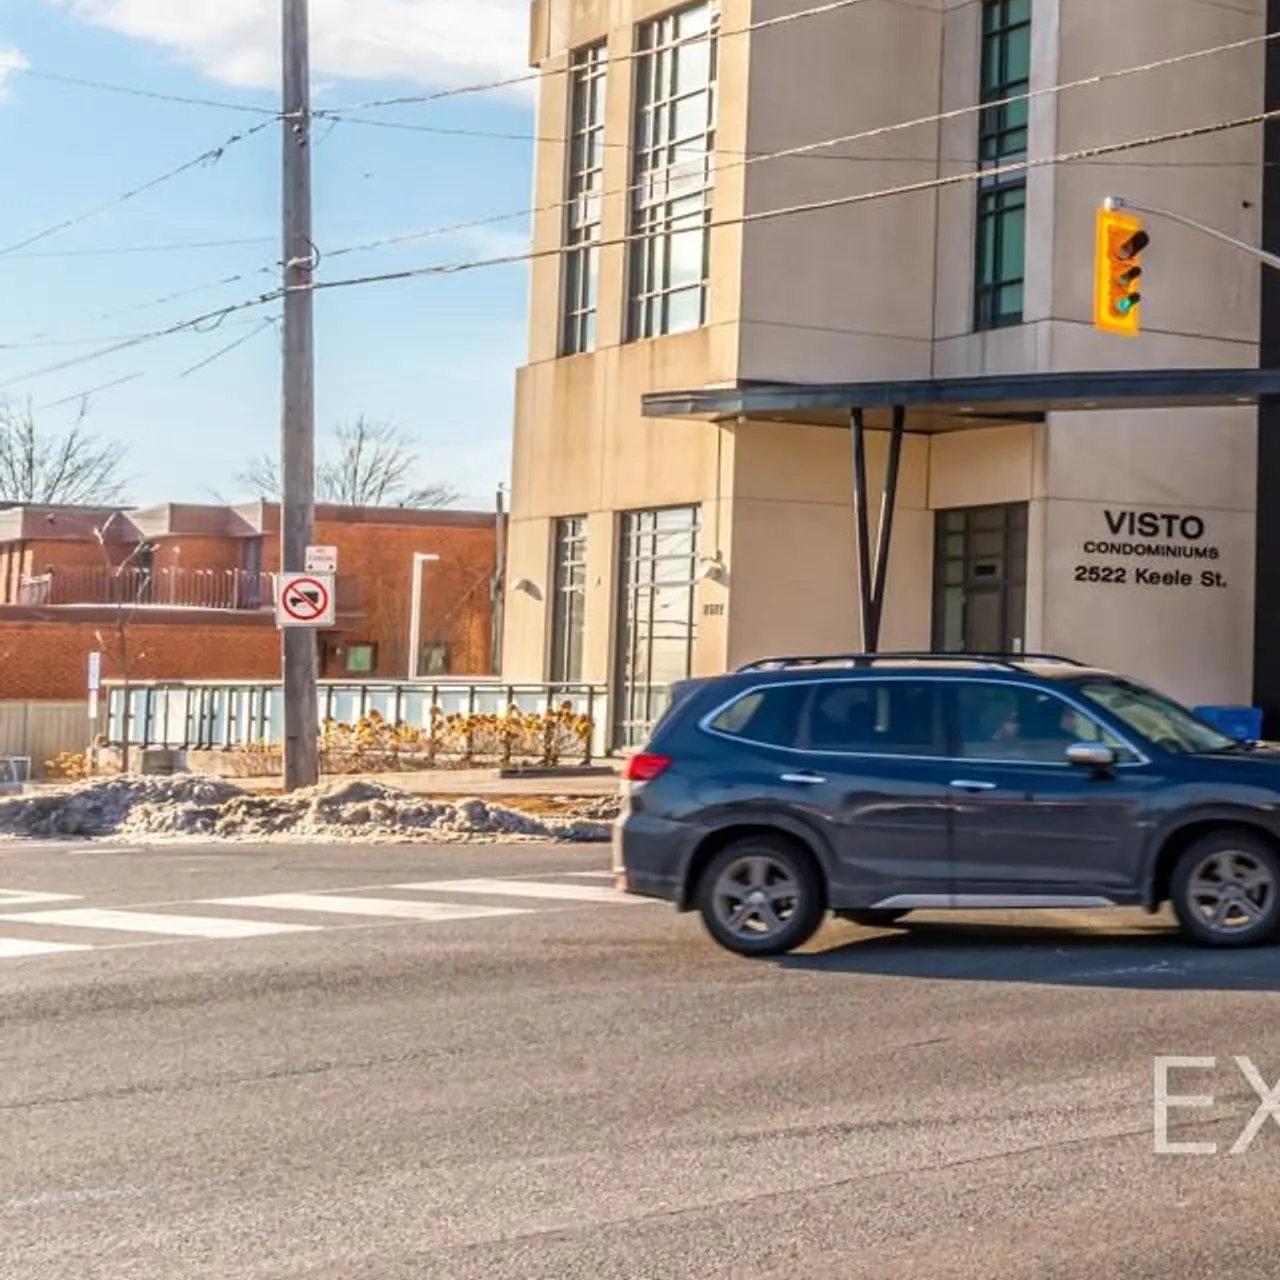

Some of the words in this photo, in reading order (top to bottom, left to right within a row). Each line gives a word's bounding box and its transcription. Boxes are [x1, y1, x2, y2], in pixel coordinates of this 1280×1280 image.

[1104, 510, 1205, 540] VISTO
[1083, 541, 1220, 560] CONDOMINIUMS
[1074, 565, 1127, 583] 2522
[1135, 568, 1192, 586] Keele
[1200, 570, 1228, 588] St.
